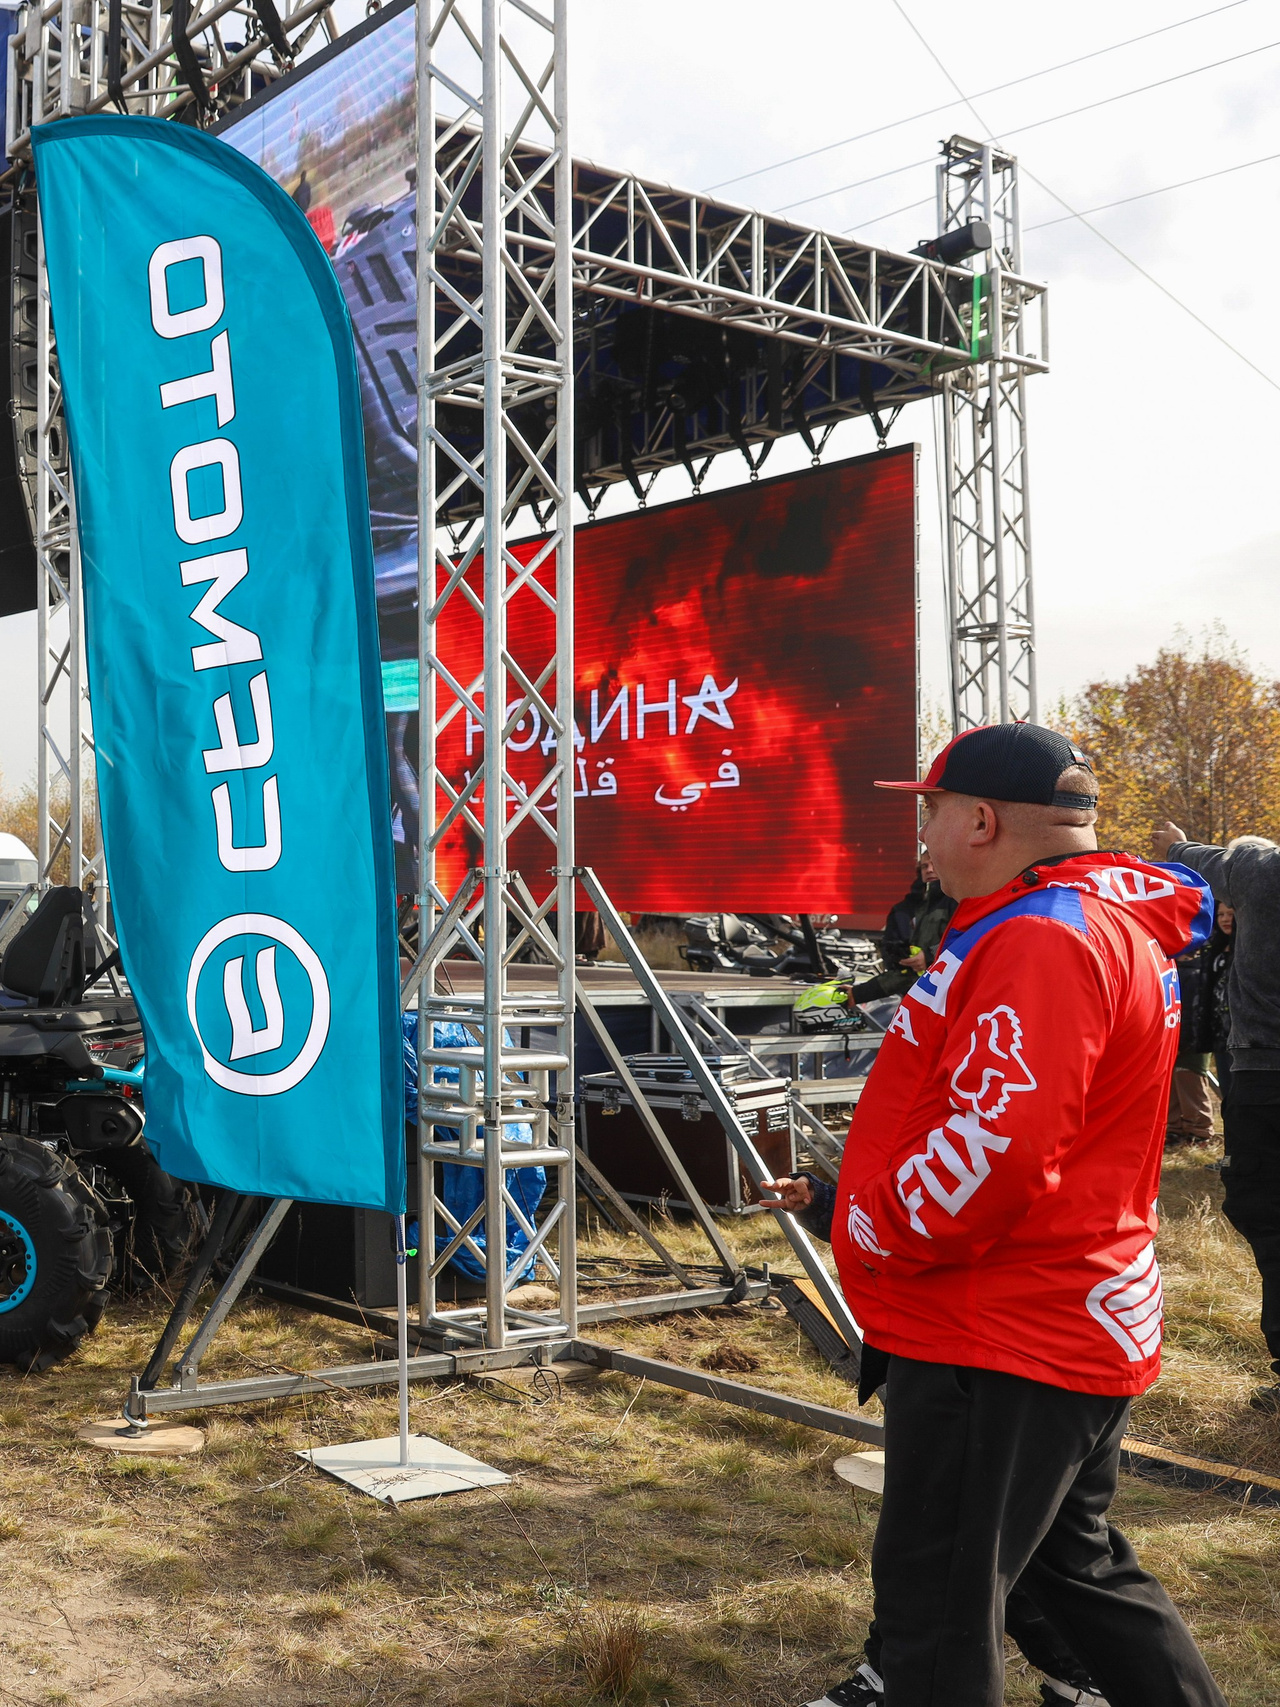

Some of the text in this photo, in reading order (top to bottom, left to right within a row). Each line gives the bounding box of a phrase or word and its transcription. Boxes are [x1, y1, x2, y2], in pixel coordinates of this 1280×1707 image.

[654, 748, 740, 811] في
[1084, 866, 1176, 903] FOX
[896, 1110, 1012, 1239] FOX
